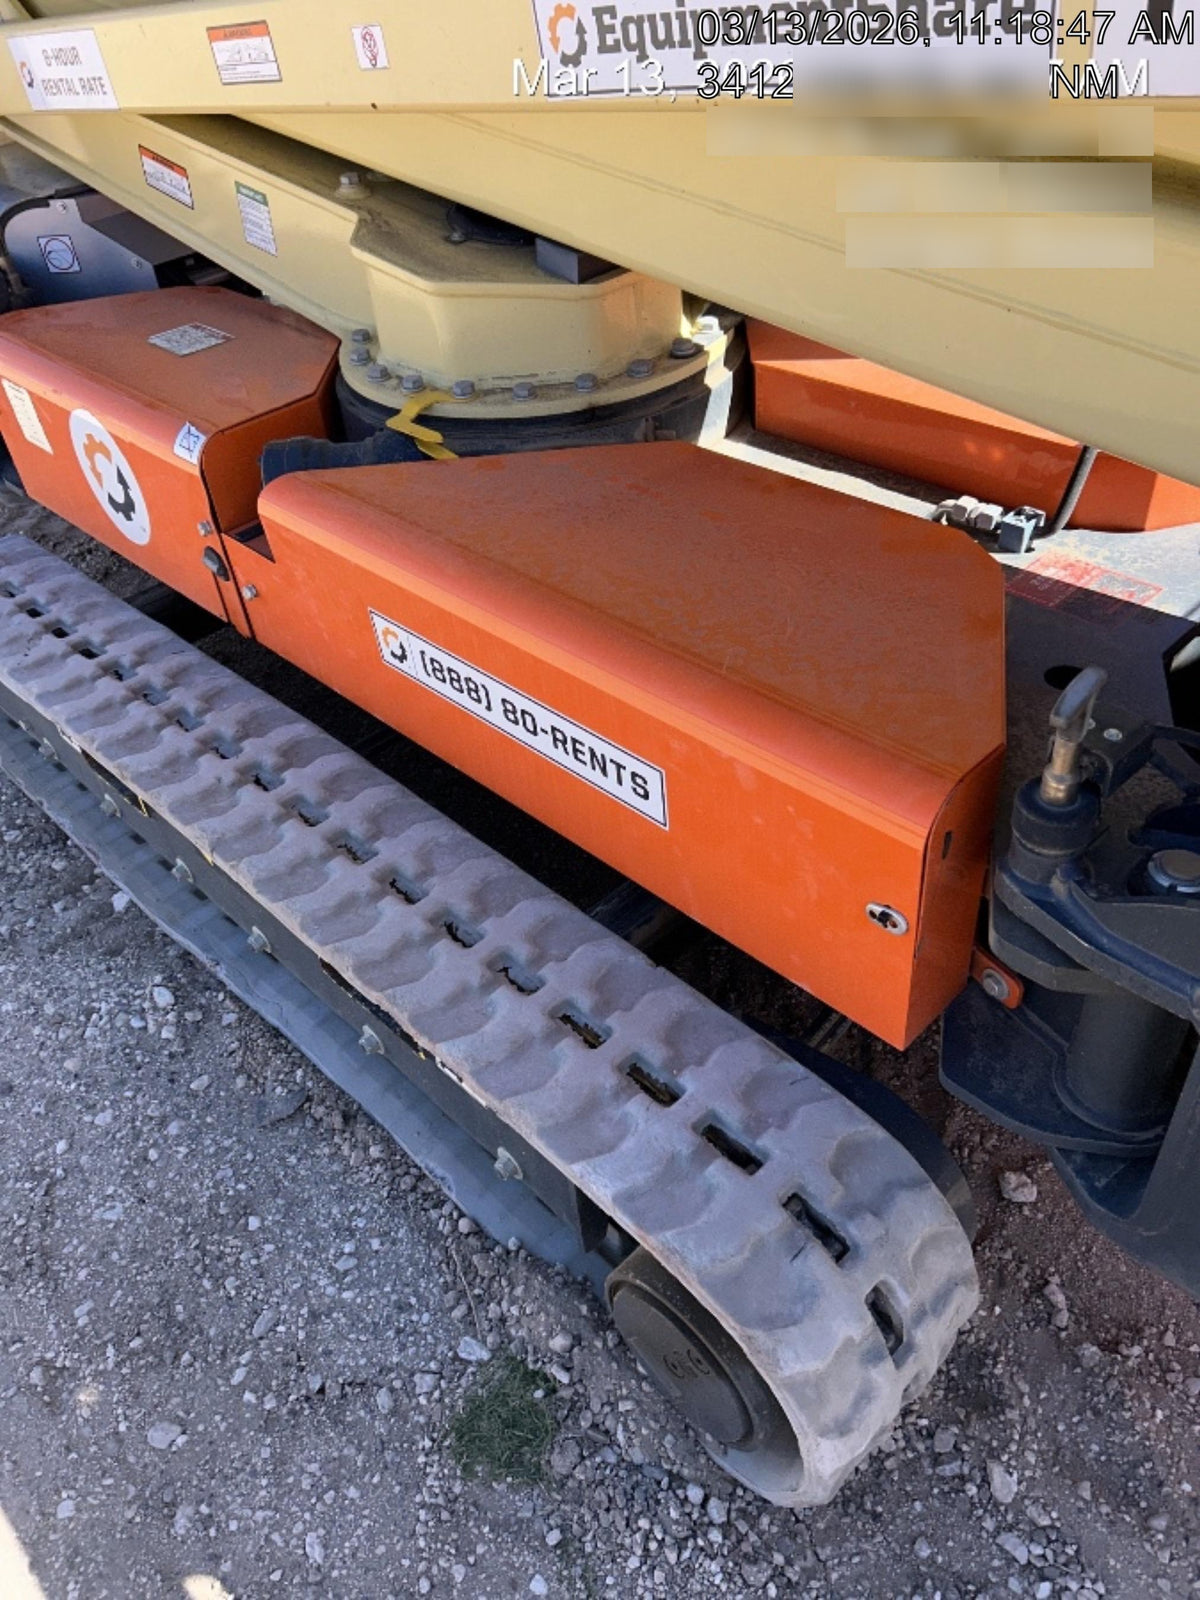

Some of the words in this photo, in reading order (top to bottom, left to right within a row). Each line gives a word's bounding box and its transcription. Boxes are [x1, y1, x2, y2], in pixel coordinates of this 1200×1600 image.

[41, 77, 80, 96] RENTAL
[78, 75, 107, 95] RATE
[419, 649, 493, 712] (888)
[501, 697, 651, 801] 80-RENTS
